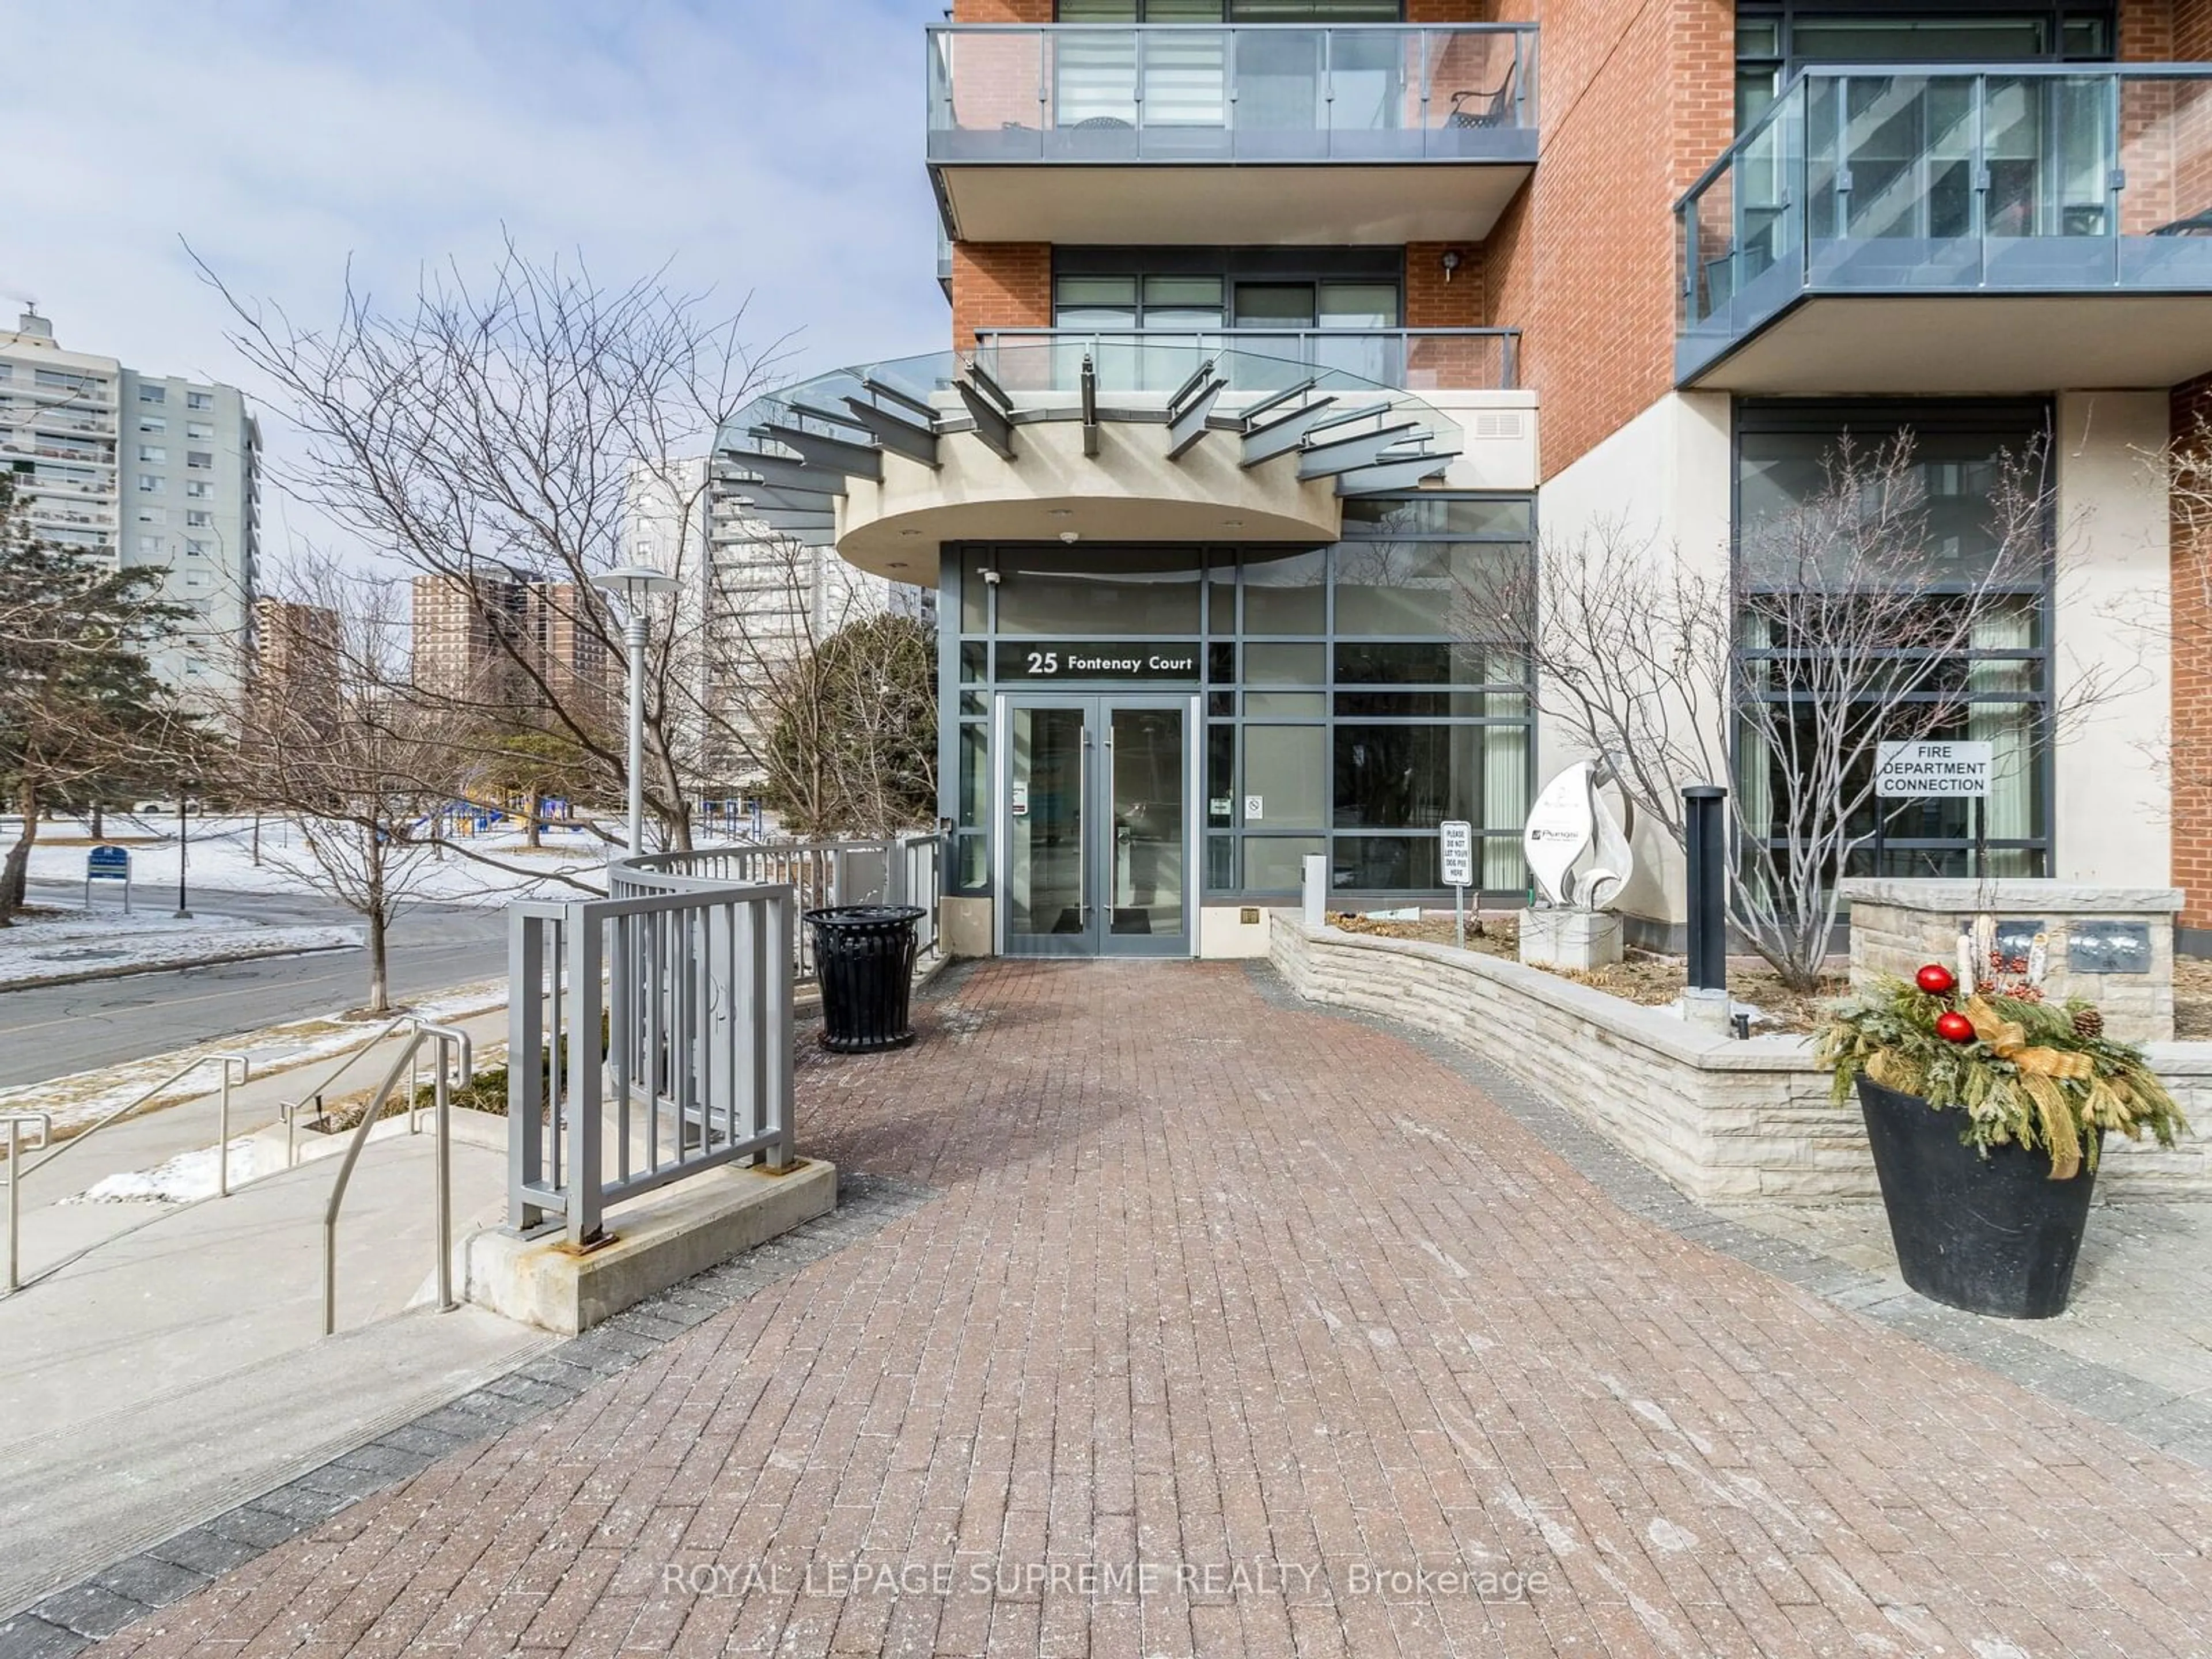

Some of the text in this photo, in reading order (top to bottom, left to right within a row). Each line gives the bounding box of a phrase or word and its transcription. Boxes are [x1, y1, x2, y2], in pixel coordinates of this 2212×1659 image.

[1027, 652, 1192, 673] 25 Fontenay Court
[1918, 746, 1952, 758] FIRE
[1884, 763, 1986, 774] DEPARTMENT
[1884, 779, 1984, 790] CONNECTION
[1446, 830, 1464, 838] PLEASE
